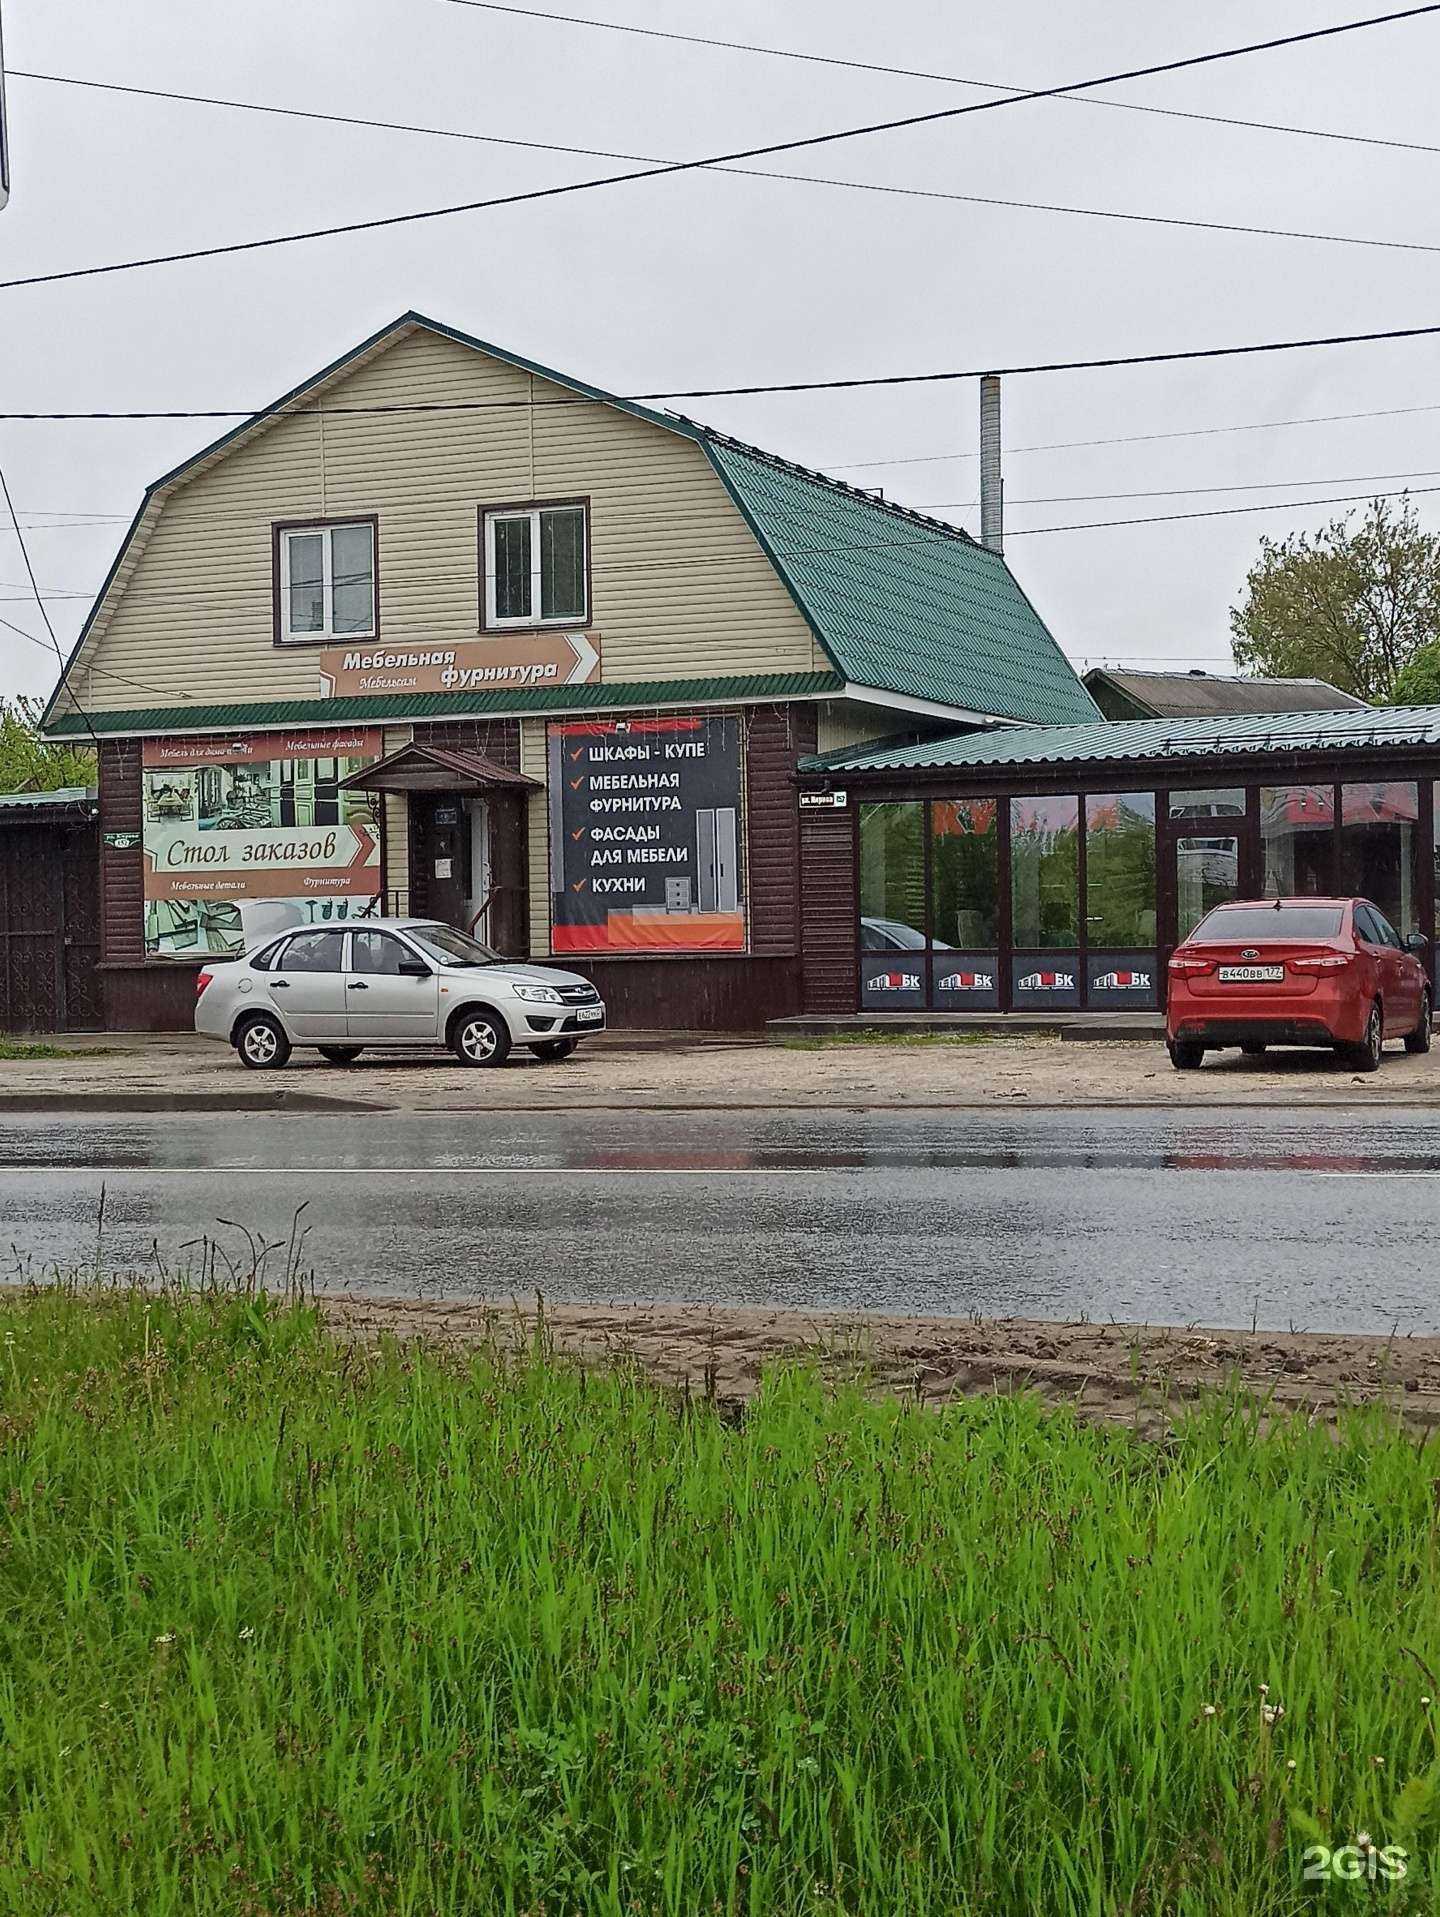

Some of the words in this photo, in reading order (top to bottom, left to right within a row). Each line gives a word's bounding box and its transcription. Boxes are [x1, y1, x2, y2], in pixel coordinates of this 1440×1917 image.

[343, 650, 455, 671] Мебельная
[441, 661, 558, 689] фурнитура
[588, 745, 650, 762] ШКАФЫ
[664, 742, 706, 759] КУПЕ
[589, 773, 680, 791] МЕБЕЛЬНАЯ
[589, 795, 682, 813] ФУРНИТУРА
[590, 825, 660, 842] ФАСАДЫ
[167, 839, 231, 867] Стол
[241, 831, 337, 863] заказов
[590, 849, 622, 866] ДЛЯ
[627, 847, 688, 863] МЕБЕЛИ
[591, 877, 646, 893] КУХНИ
